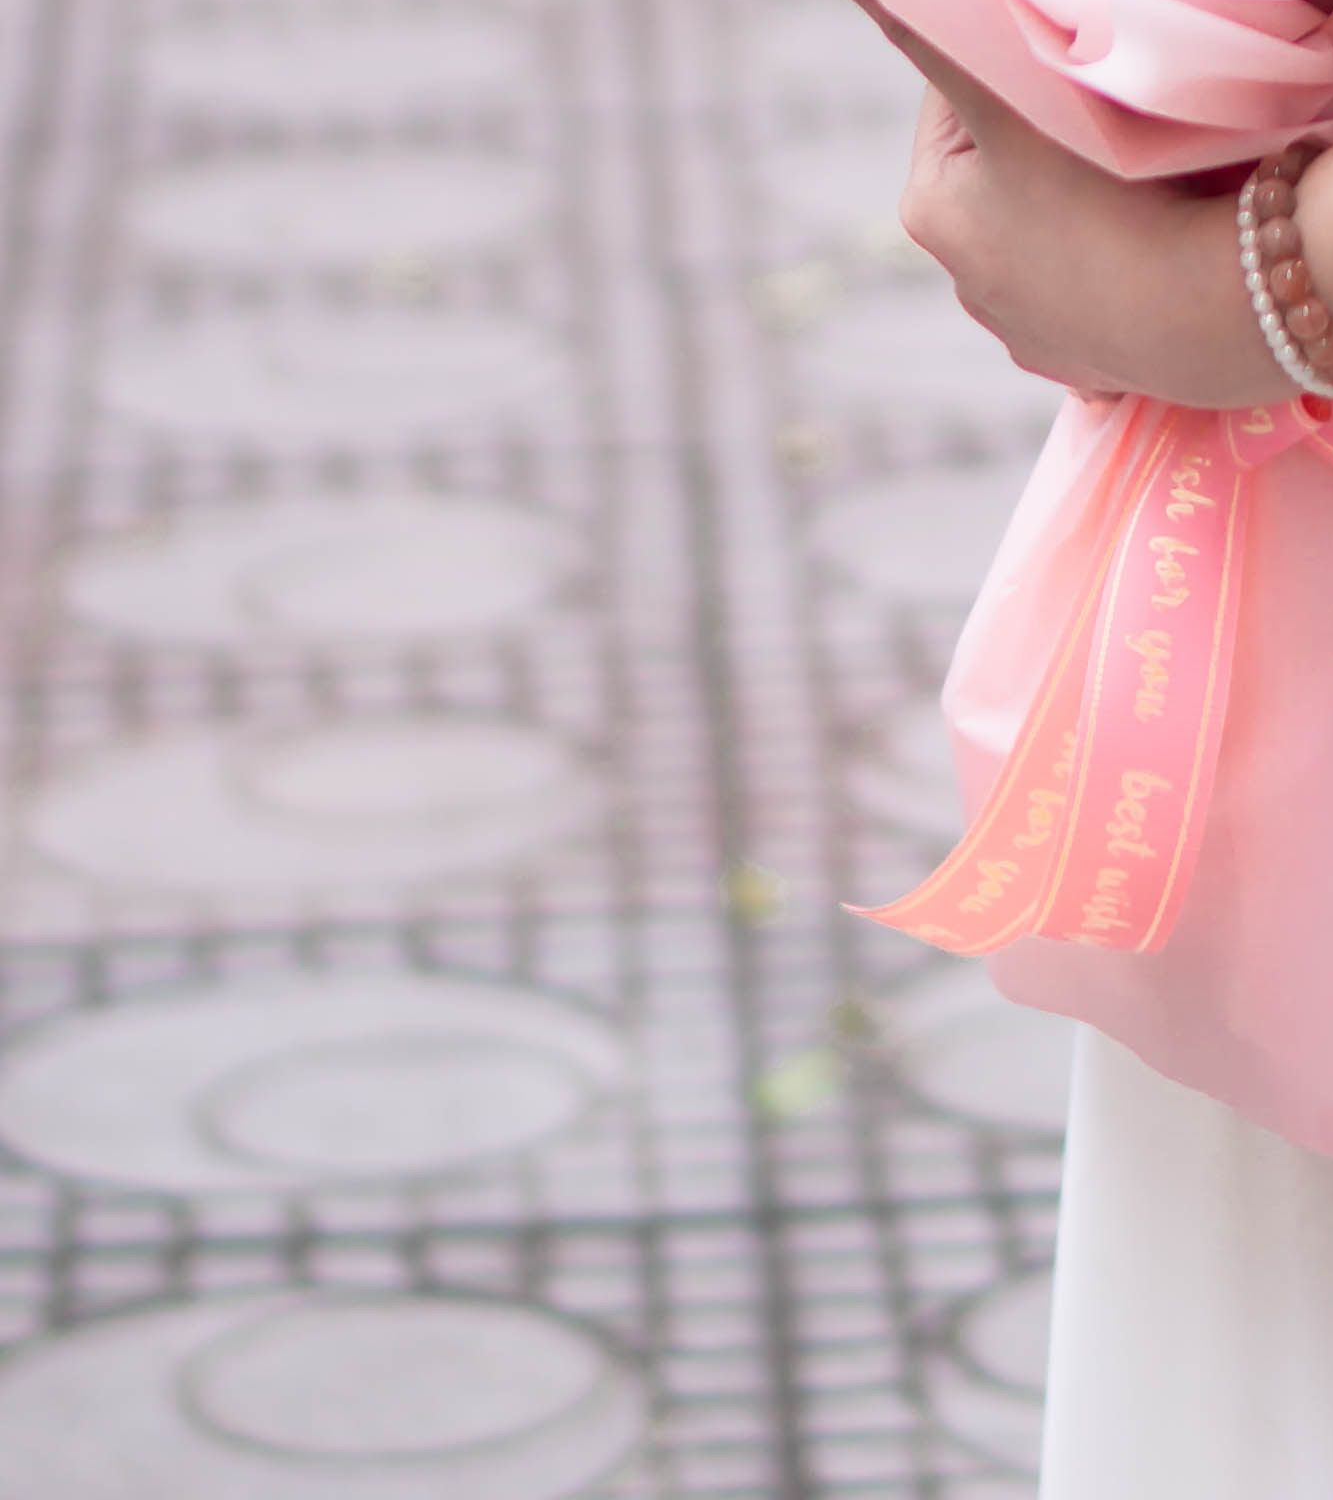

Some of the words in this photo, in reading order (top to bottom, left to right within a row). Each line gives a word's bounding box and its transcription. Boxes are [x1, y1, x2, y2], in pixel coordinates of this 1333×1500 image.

[1166, 454, 1216, 523] ish
[1148, 535, 1201, 611] for
[1124, 629, 1174, 723] you
[1012, 787, 1066, 850] for
[1105, 769, 1174, 859] best
[957, 858, 1021, 914] you
[1080, 867, 1133, 931] wish
